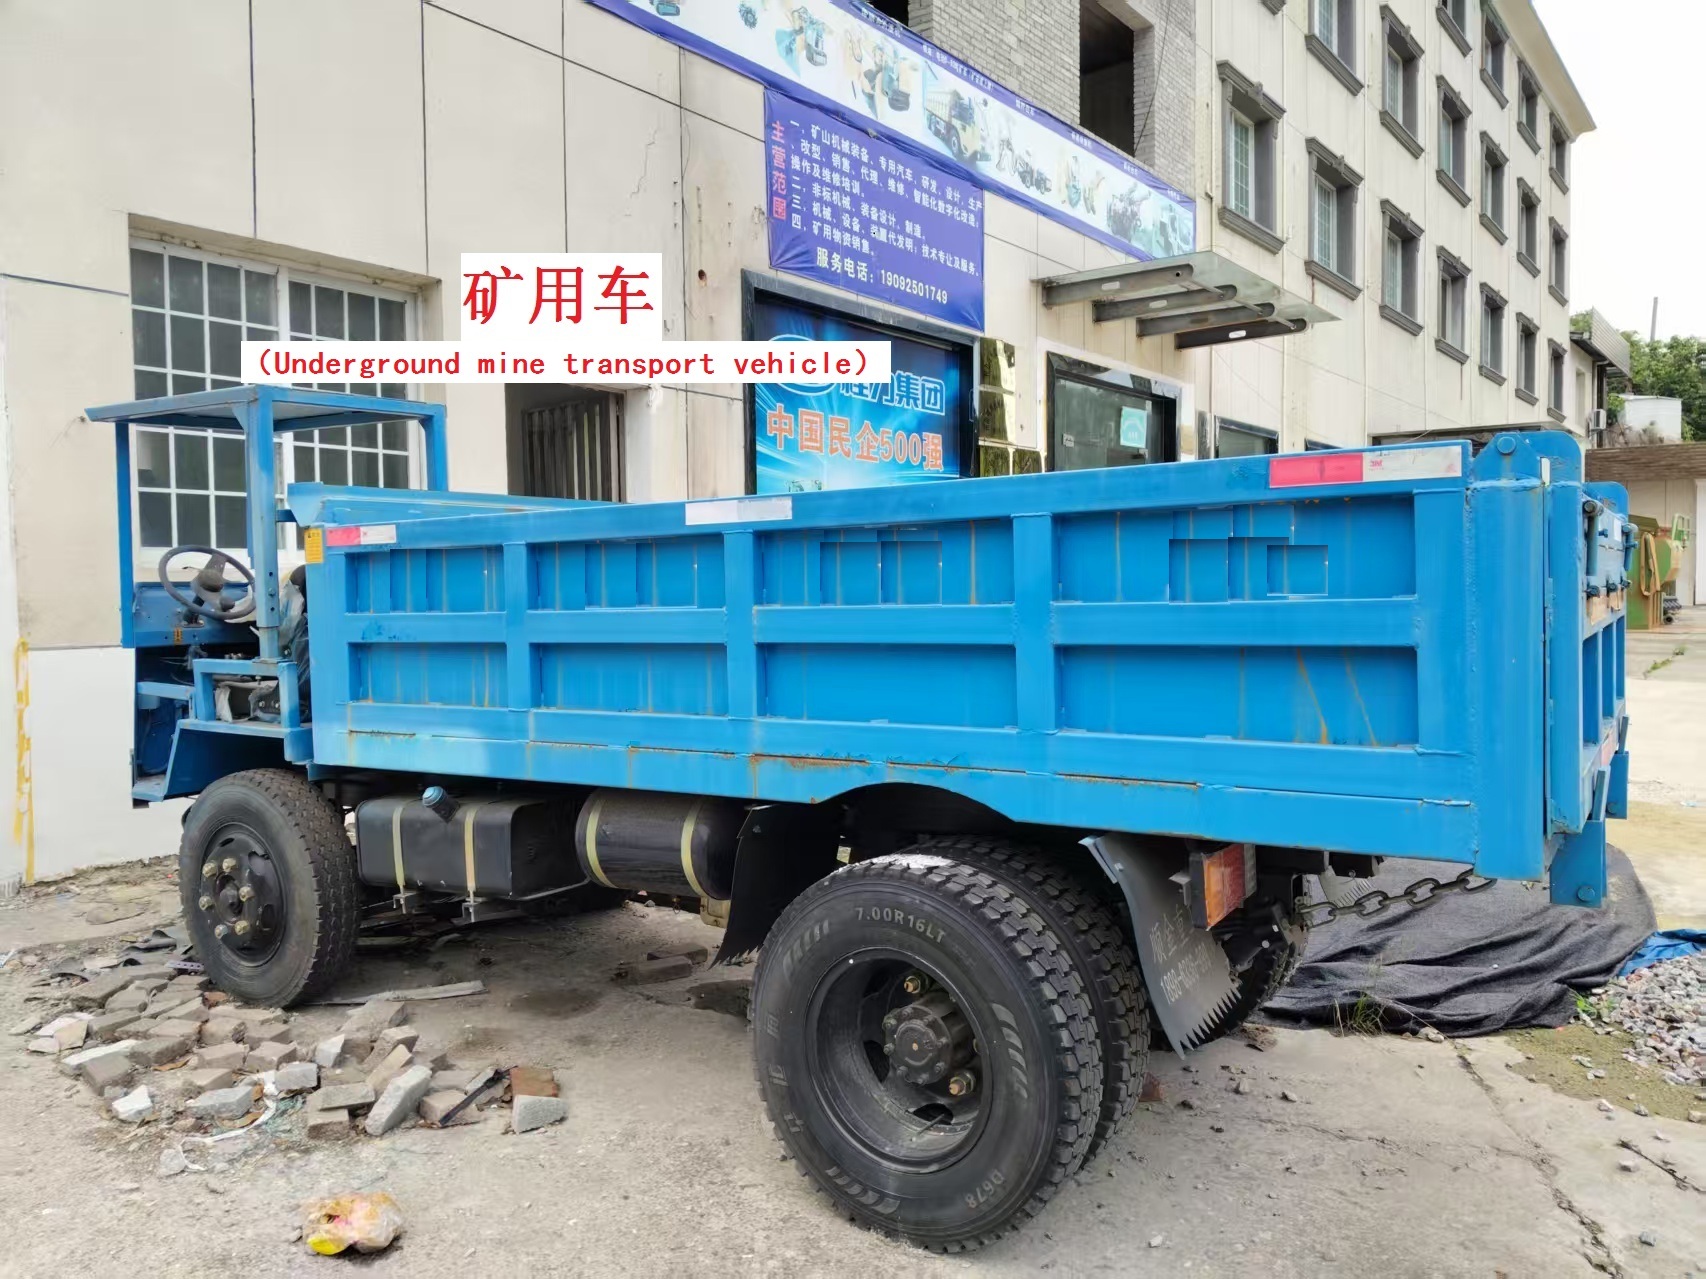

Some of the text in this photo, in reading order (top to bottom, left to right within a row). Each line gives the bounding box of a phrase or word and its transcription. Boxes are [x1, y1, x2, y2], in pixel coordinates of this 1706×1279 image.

[771, 120, 787, 220] 主营范围
[767, 402, 944, 472] 中国民企500强
[855, 906, 946, 943] 7.00R16LT
